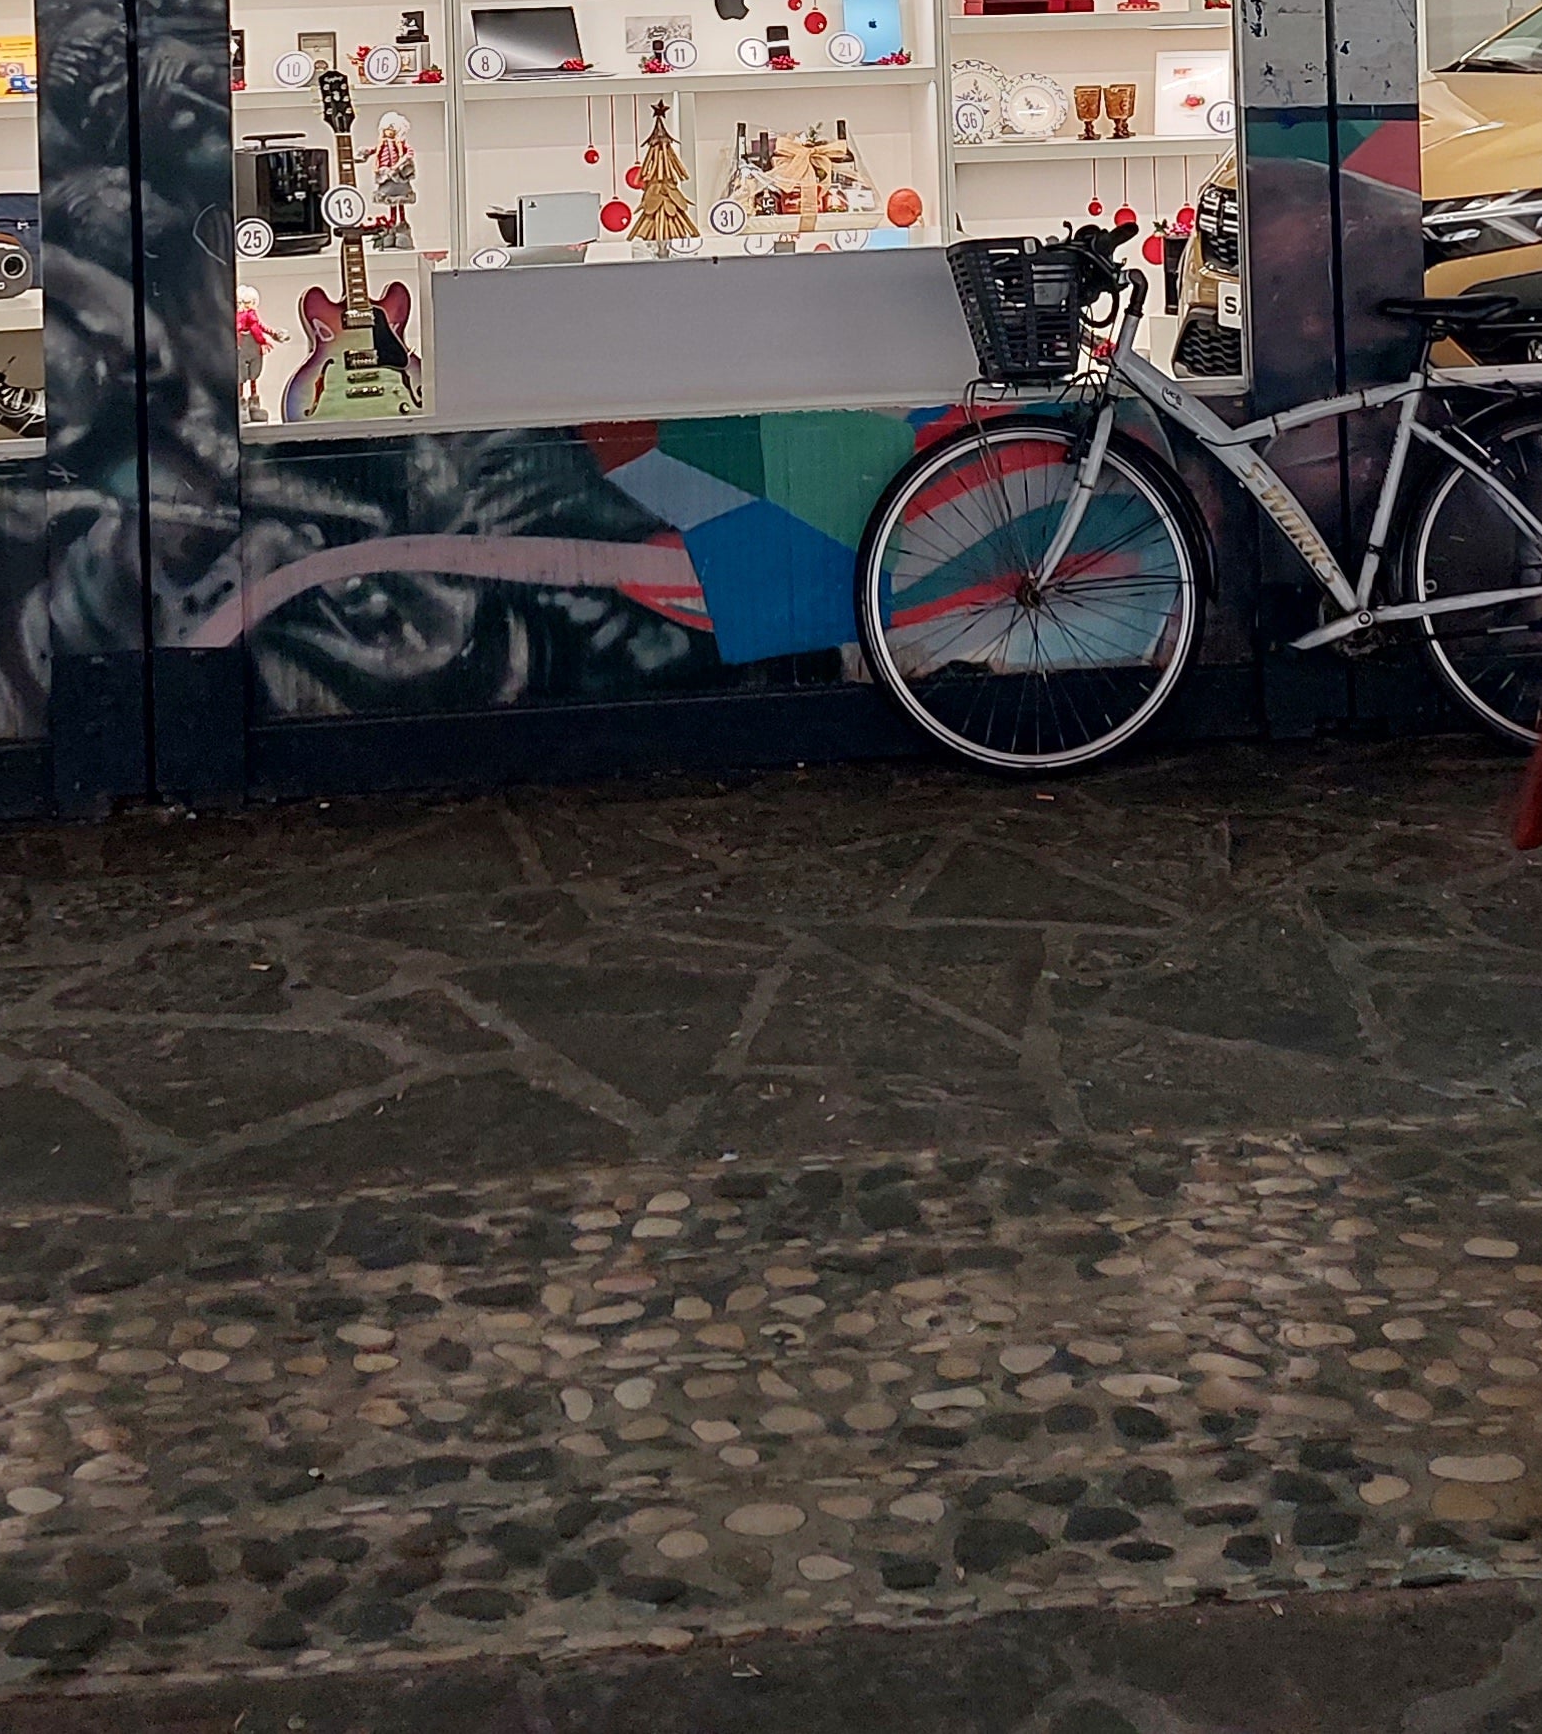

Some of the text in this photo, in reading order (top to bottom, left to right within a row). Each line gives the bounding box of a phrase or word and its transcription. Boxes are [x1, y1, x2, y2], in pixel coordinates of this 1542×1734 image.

[674, 47, 686, 63] 11
[748, 45, 757, 62] 7
[839, 42, 853, 57] 21
[286, 61, 301, 77] 10
[376, 56, 390, 74] 16
[482, 55, 490, 72] 8
[962, 113, 978, 129] 36
[1216, 109, 1231, 126] 41
[335, 197, 354, 219] 13
[720, 209, 735, 227] 31
[243, 229, 263, 249] 25
